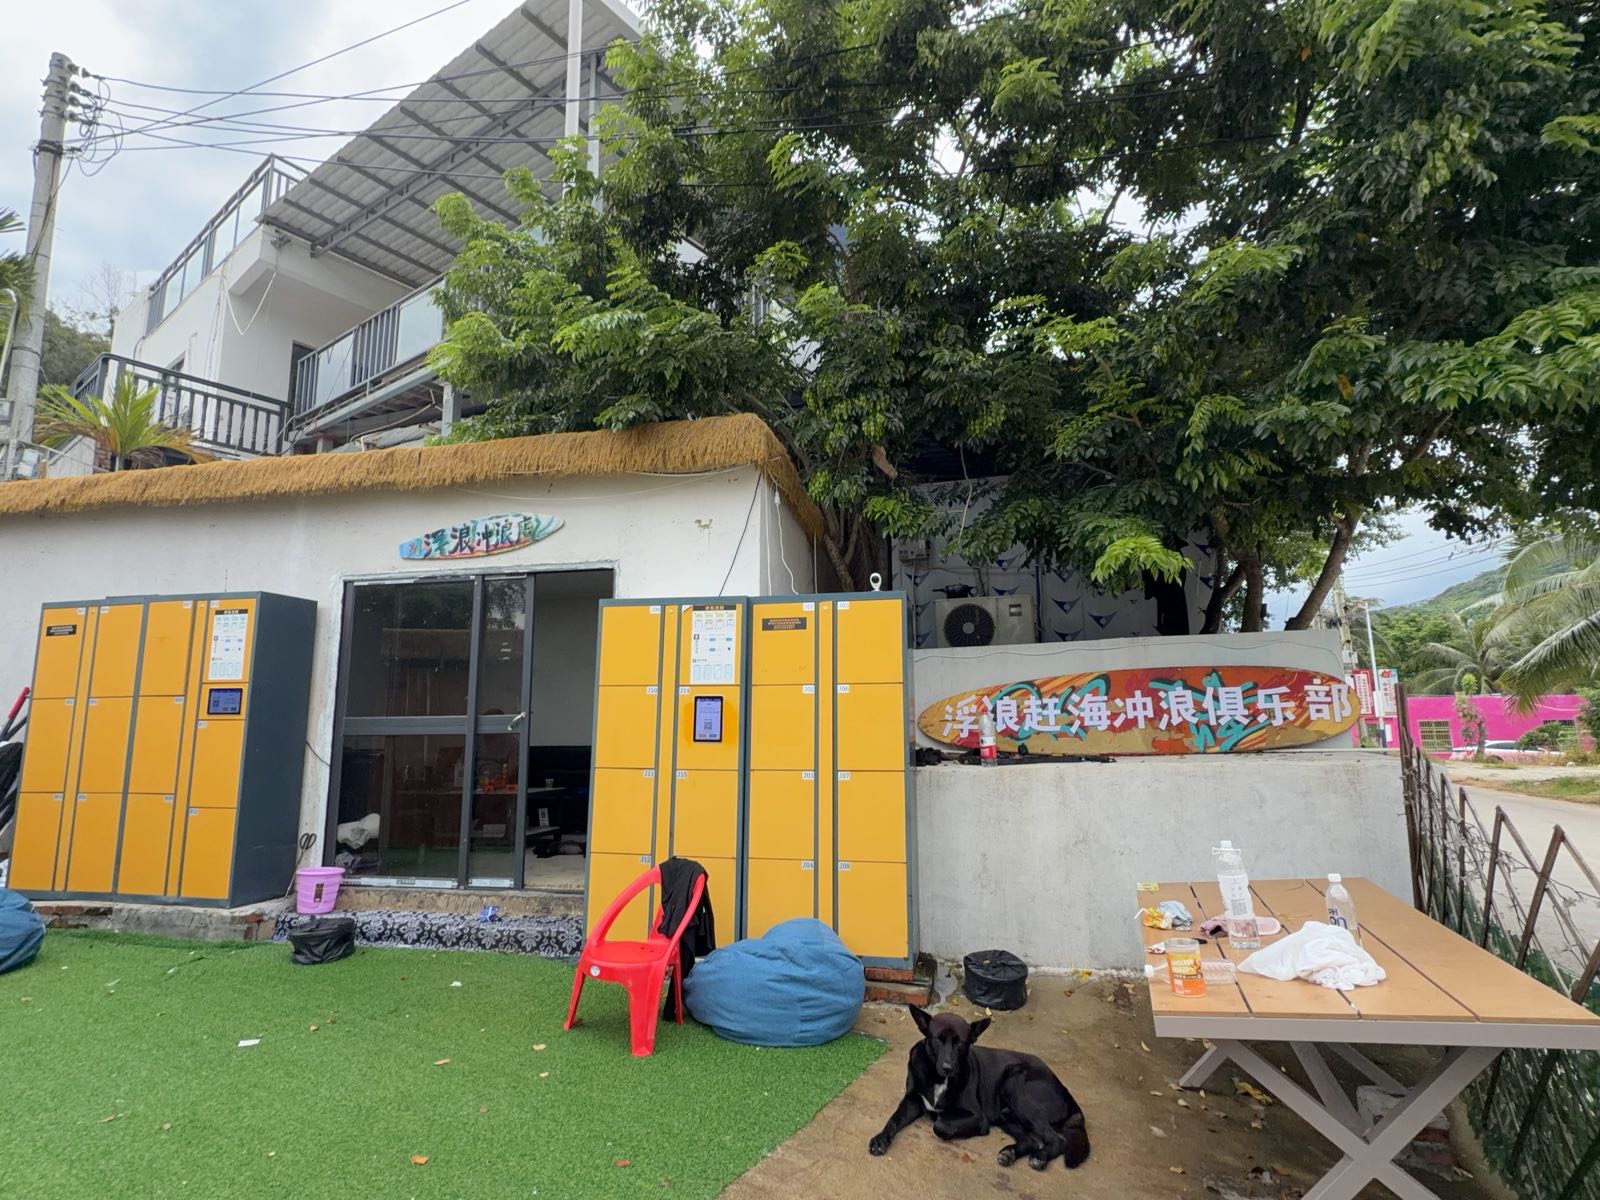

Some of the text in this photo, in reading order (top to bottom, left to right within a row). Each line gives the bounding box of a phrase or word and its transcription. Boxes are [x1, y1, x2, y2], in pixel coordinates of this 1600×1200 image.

[942, 678, 1353, 737] 浮浪赶海冲浪俱乐部
